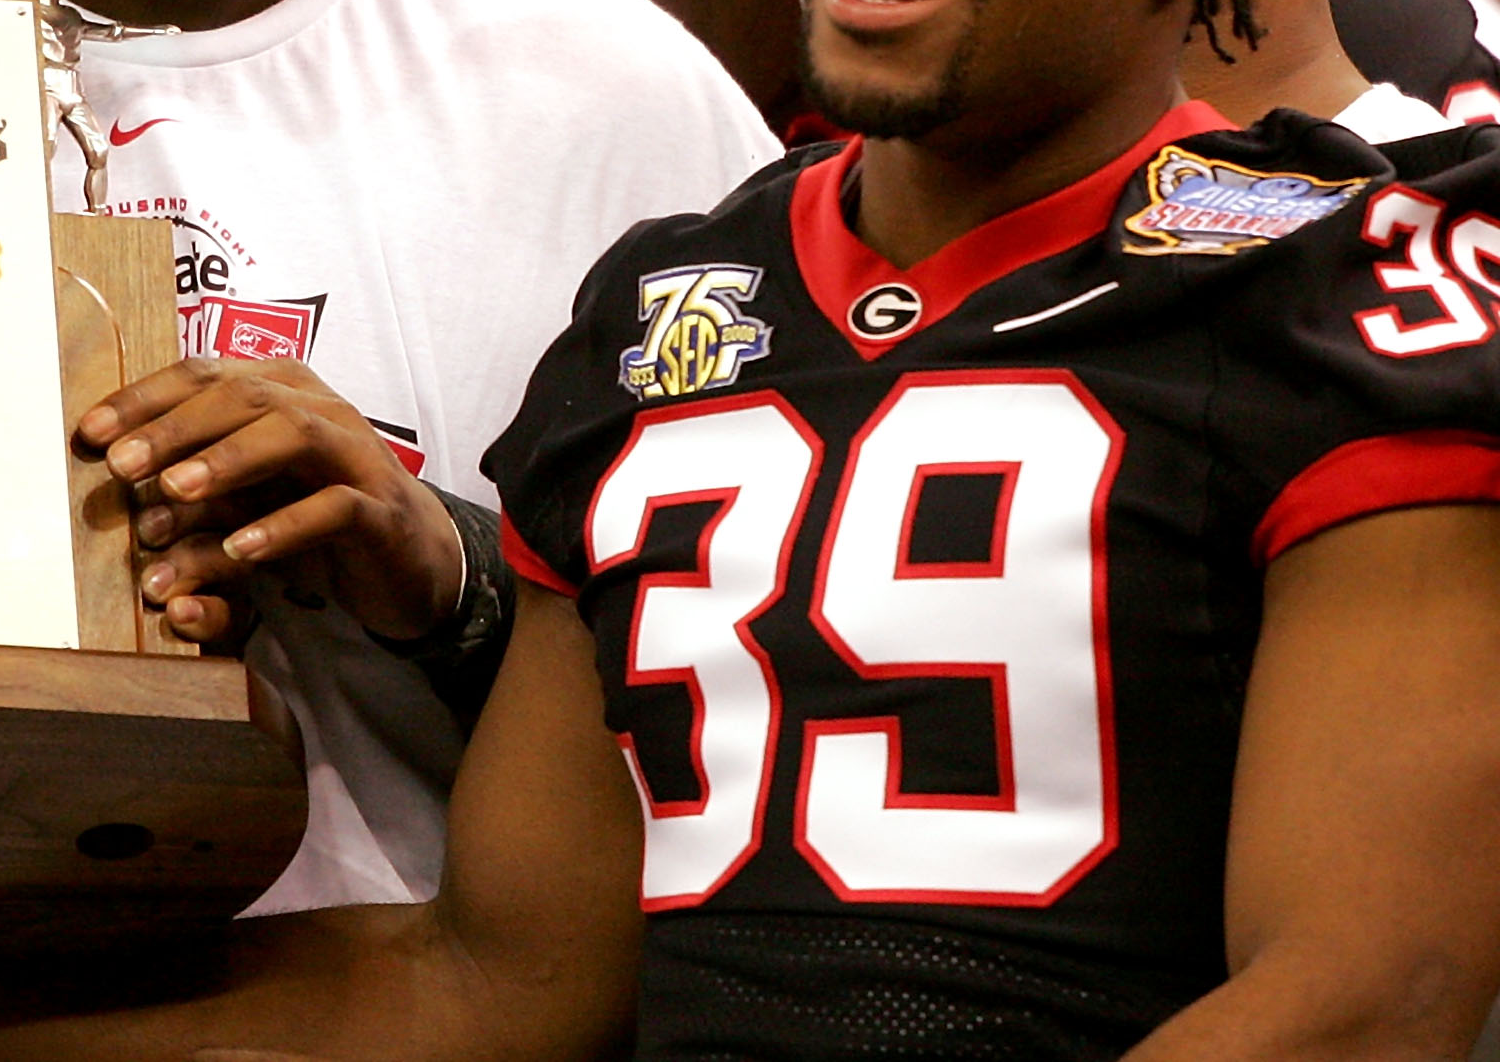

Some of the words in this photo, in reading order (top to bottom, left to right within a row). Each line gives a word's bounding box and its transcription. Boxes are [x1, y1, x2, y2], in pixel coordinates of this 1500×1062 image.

[199, 209, 258, 268] EIGHT
[643, 268, 757, 398] 75
[659, 313, 718, 396] SEC
[583, 367, 1126, 913] 39
